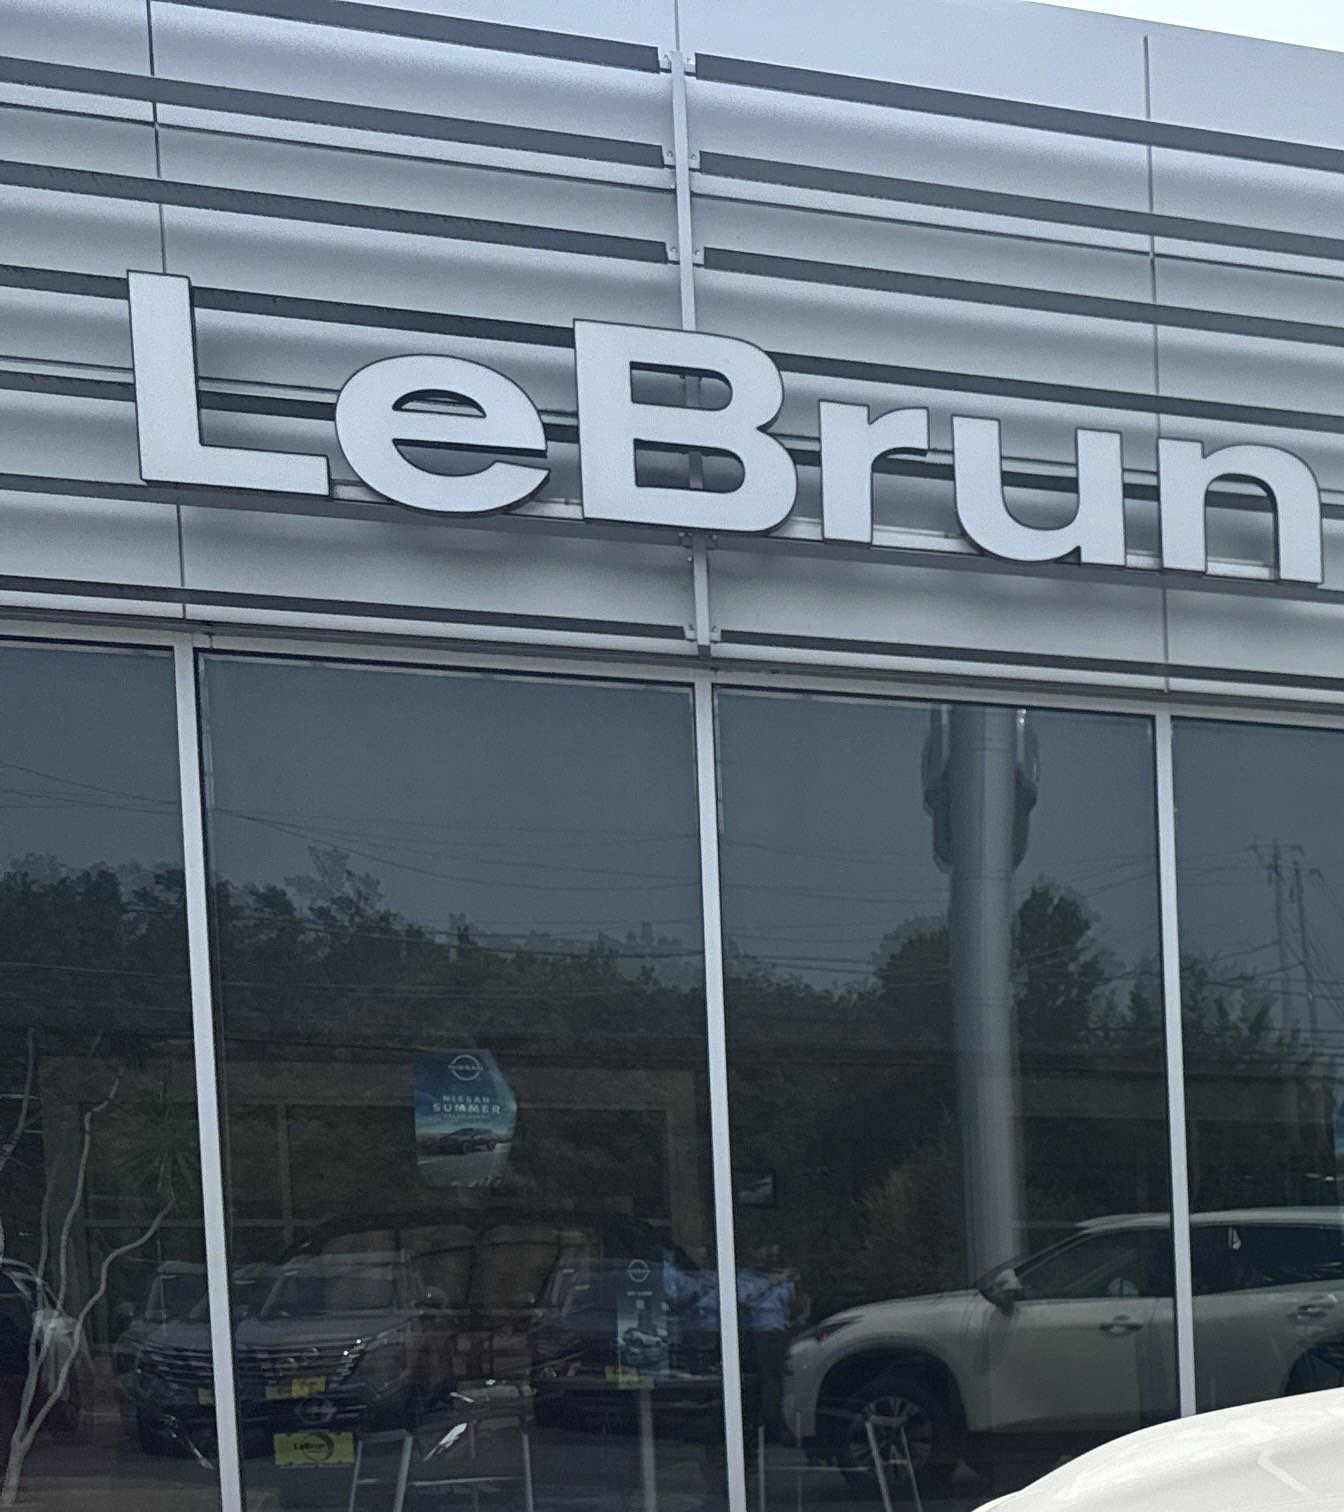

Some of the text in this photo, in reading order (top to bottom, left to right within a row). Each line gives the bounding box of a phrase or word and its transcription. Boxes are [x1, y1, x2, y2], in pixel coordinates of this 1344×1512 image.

[127, 269, 1325, 585] LeBrun
[442, 1095, 490, 1104] NISSAN
[432, 1103, 501, 1115] SUMMER
